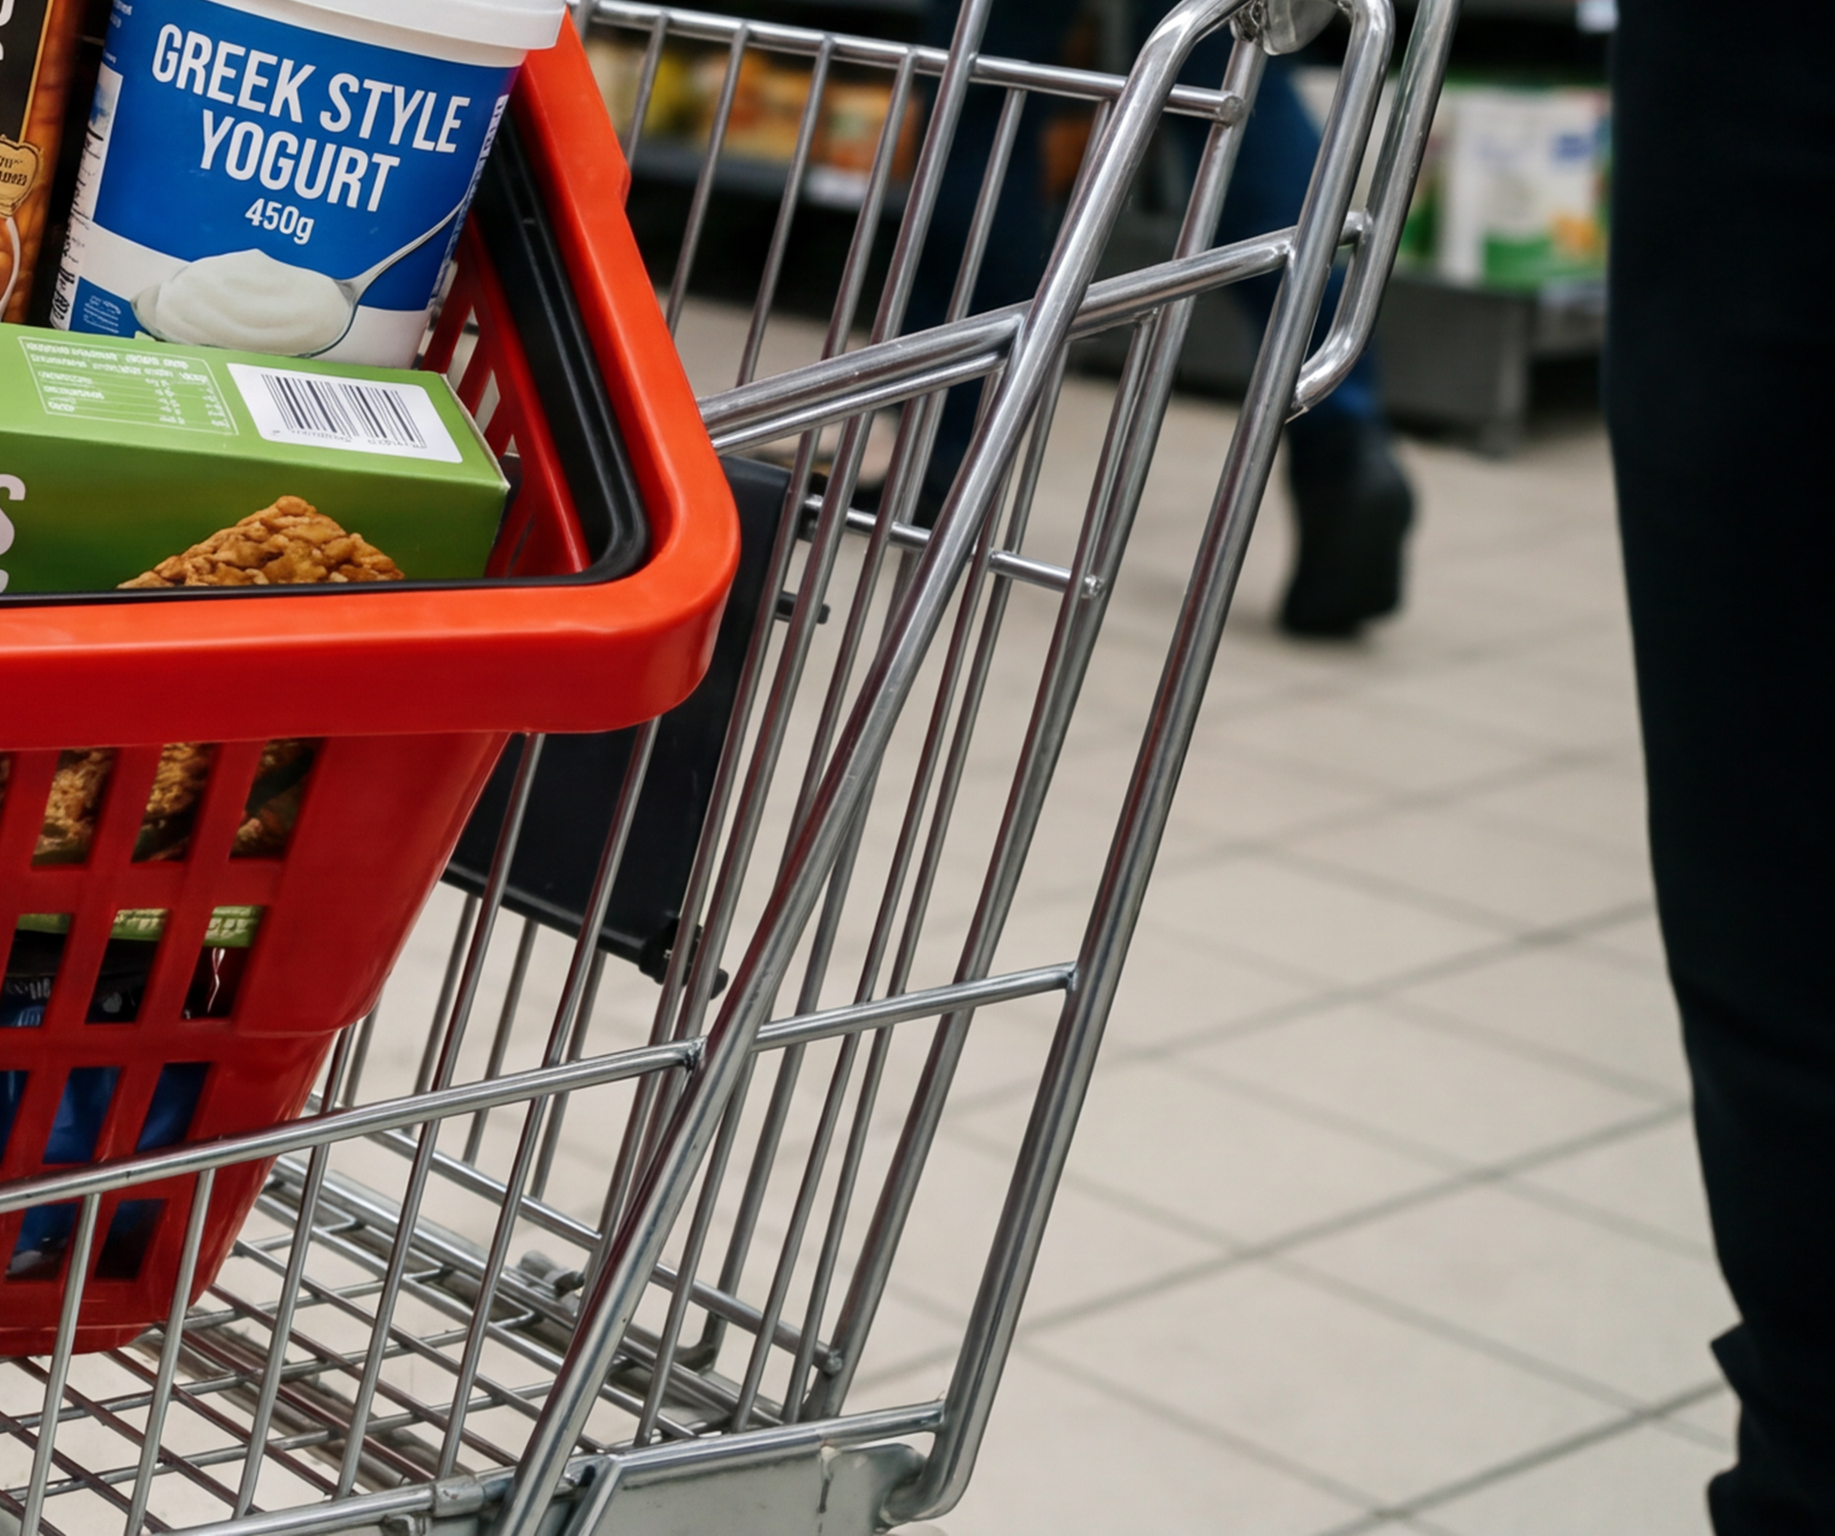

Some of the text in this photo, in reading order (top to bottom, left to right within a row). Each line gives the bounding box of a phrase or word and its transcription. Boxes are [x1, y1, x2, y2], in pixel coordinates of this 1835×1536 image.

[153, 24, 315, 123] GREEK
[320, 73, 470, 152] STYLE
[201, 110, 400, 211] YOGURT
[245, 199, 314, 244] 450g
